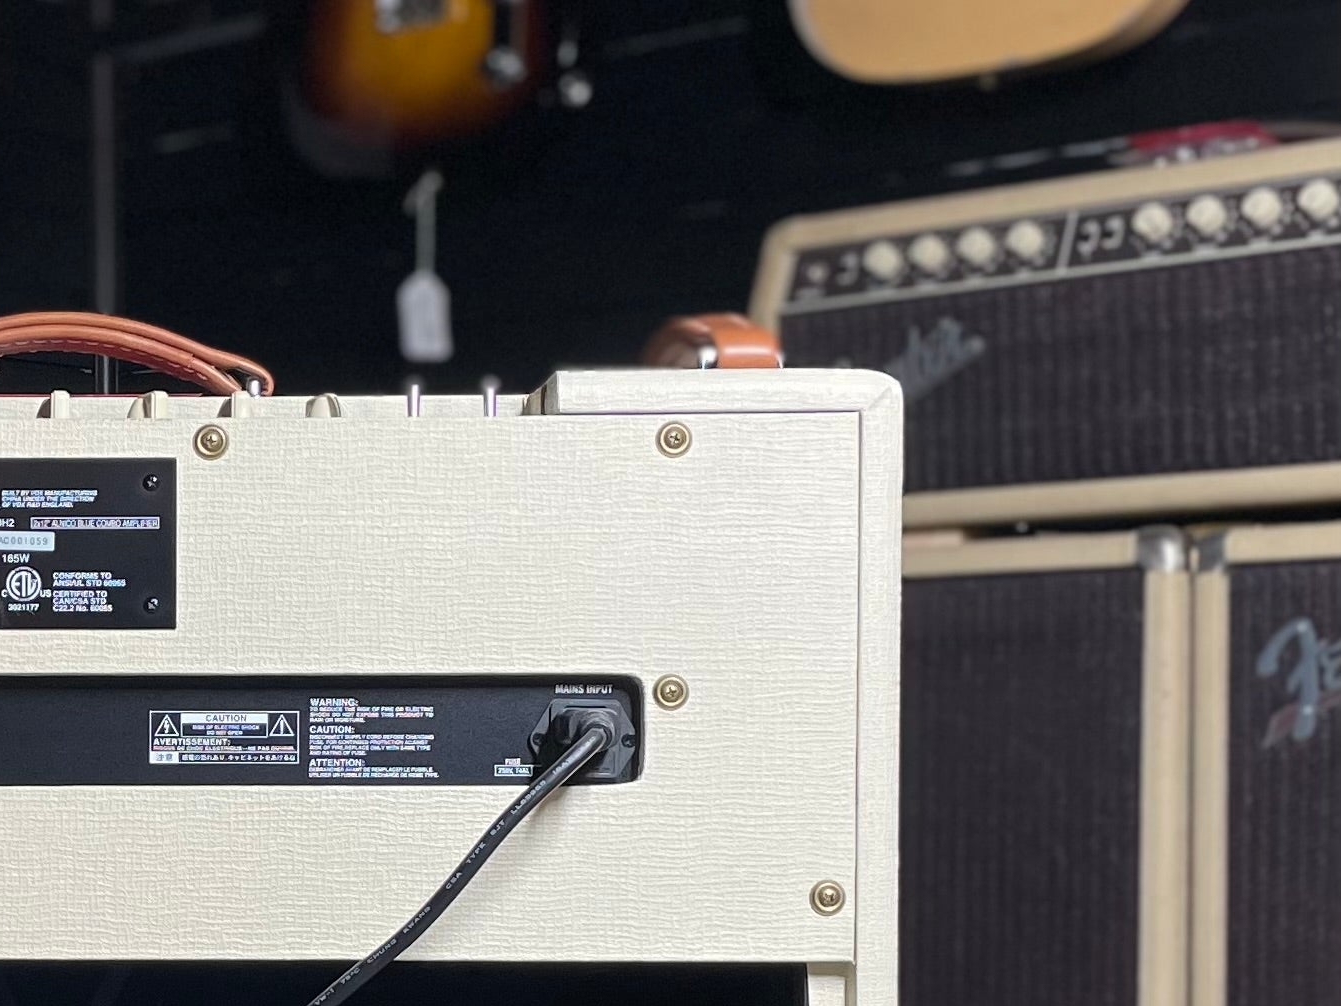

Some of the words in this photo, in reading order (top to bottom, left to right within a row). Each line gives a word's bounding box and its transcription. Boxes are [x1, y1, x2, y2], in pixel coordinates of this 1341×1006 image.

[2, 553, 30, 563] 165W
[53, 572, 99, 580] CONFORMS
[100, 572, 112, 580] TO
[86, 579, 102, 587] STD
[555, 684, 585, 694] MAINS
[586, 684, 613, 694] INPUT
[310, 698, 359, 706] WARNING:
[310, 725, 355, 734] CAUTION:
[309, 758, 366, 767] ATTENTION:
[367, 939, 397, 964] CHUNG
[446, 872, 463, 890] CSA
[465, 842, 486, 864] TYPE
